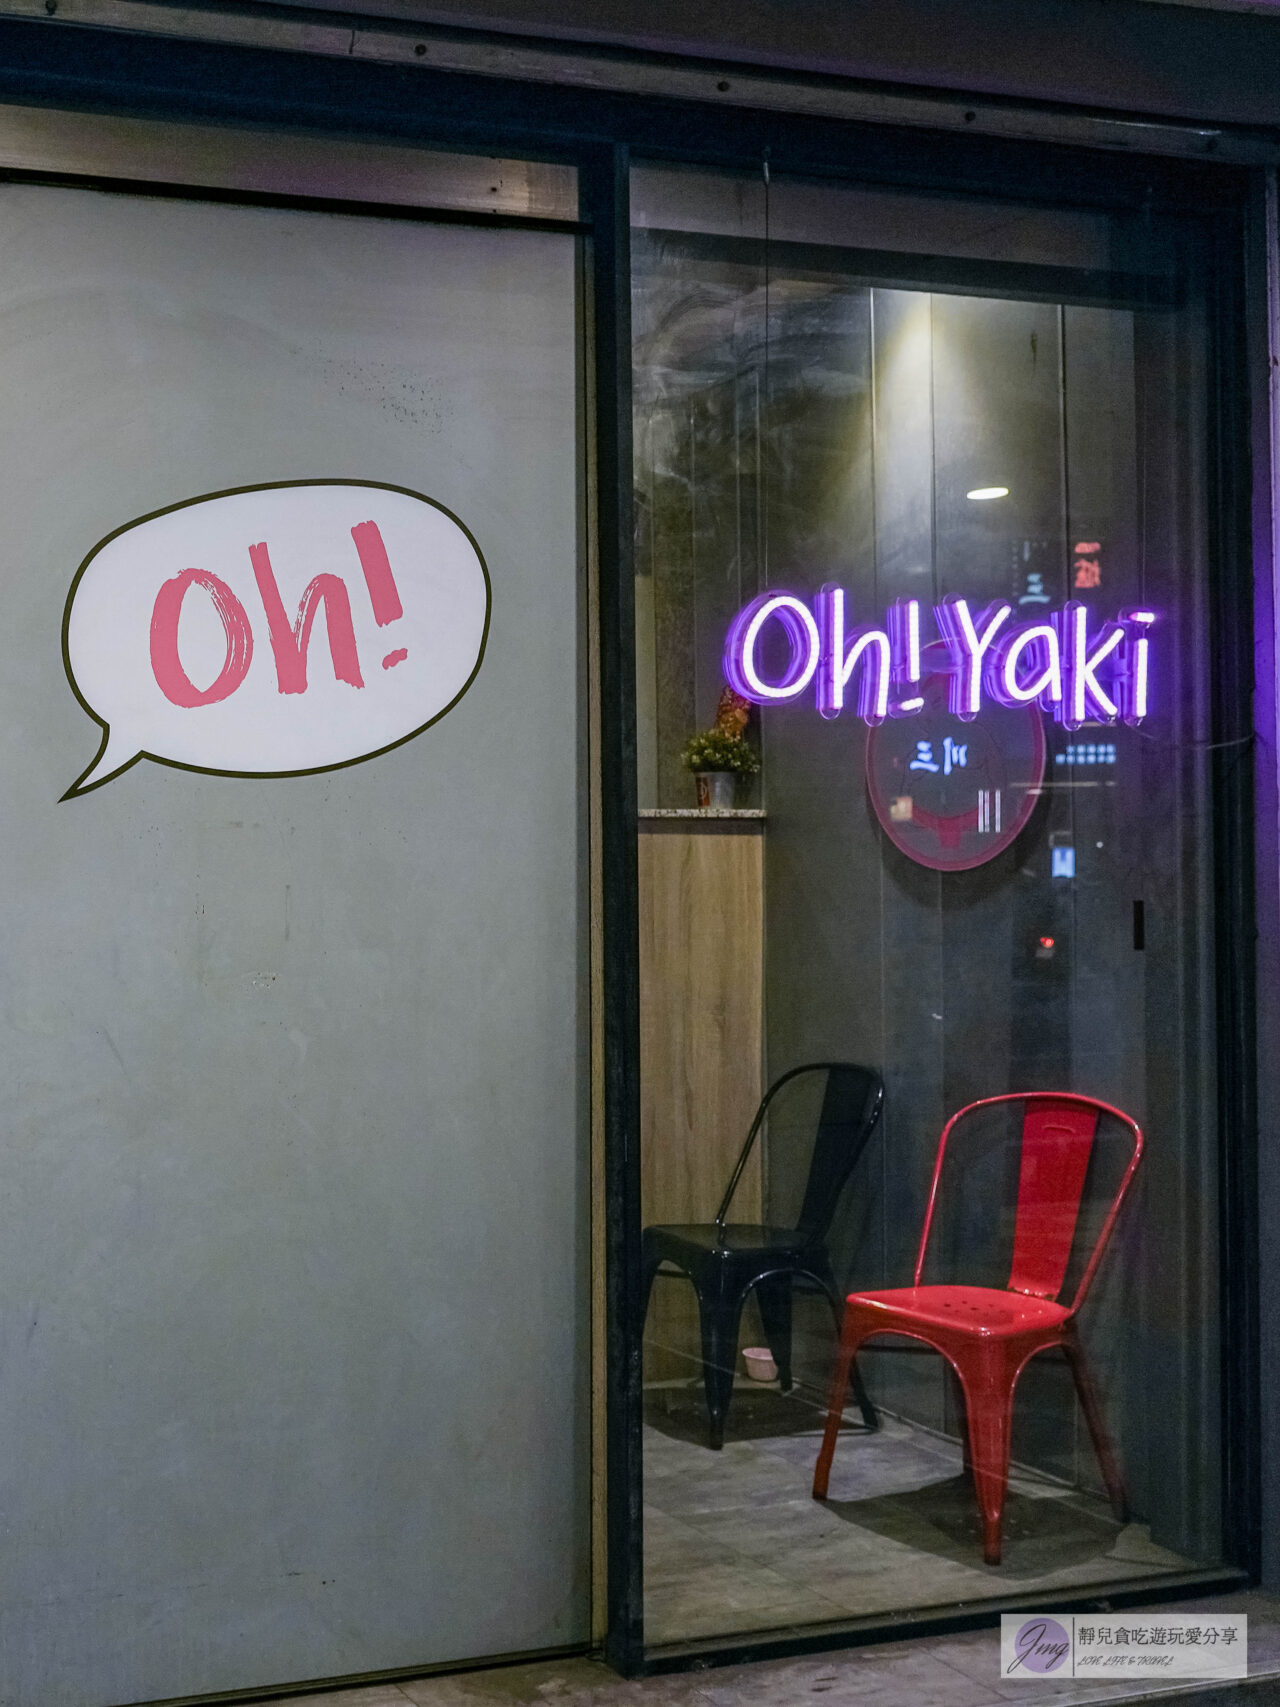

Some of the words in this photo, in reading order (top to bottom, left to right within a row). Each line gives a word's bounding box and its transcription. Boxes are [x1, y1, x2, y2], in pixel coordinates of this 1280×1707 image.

[150, 520, 408, 708] Oh!
[732, 585, 924, 720] Oh!
[946, 596, 1156, 723] Yaki
